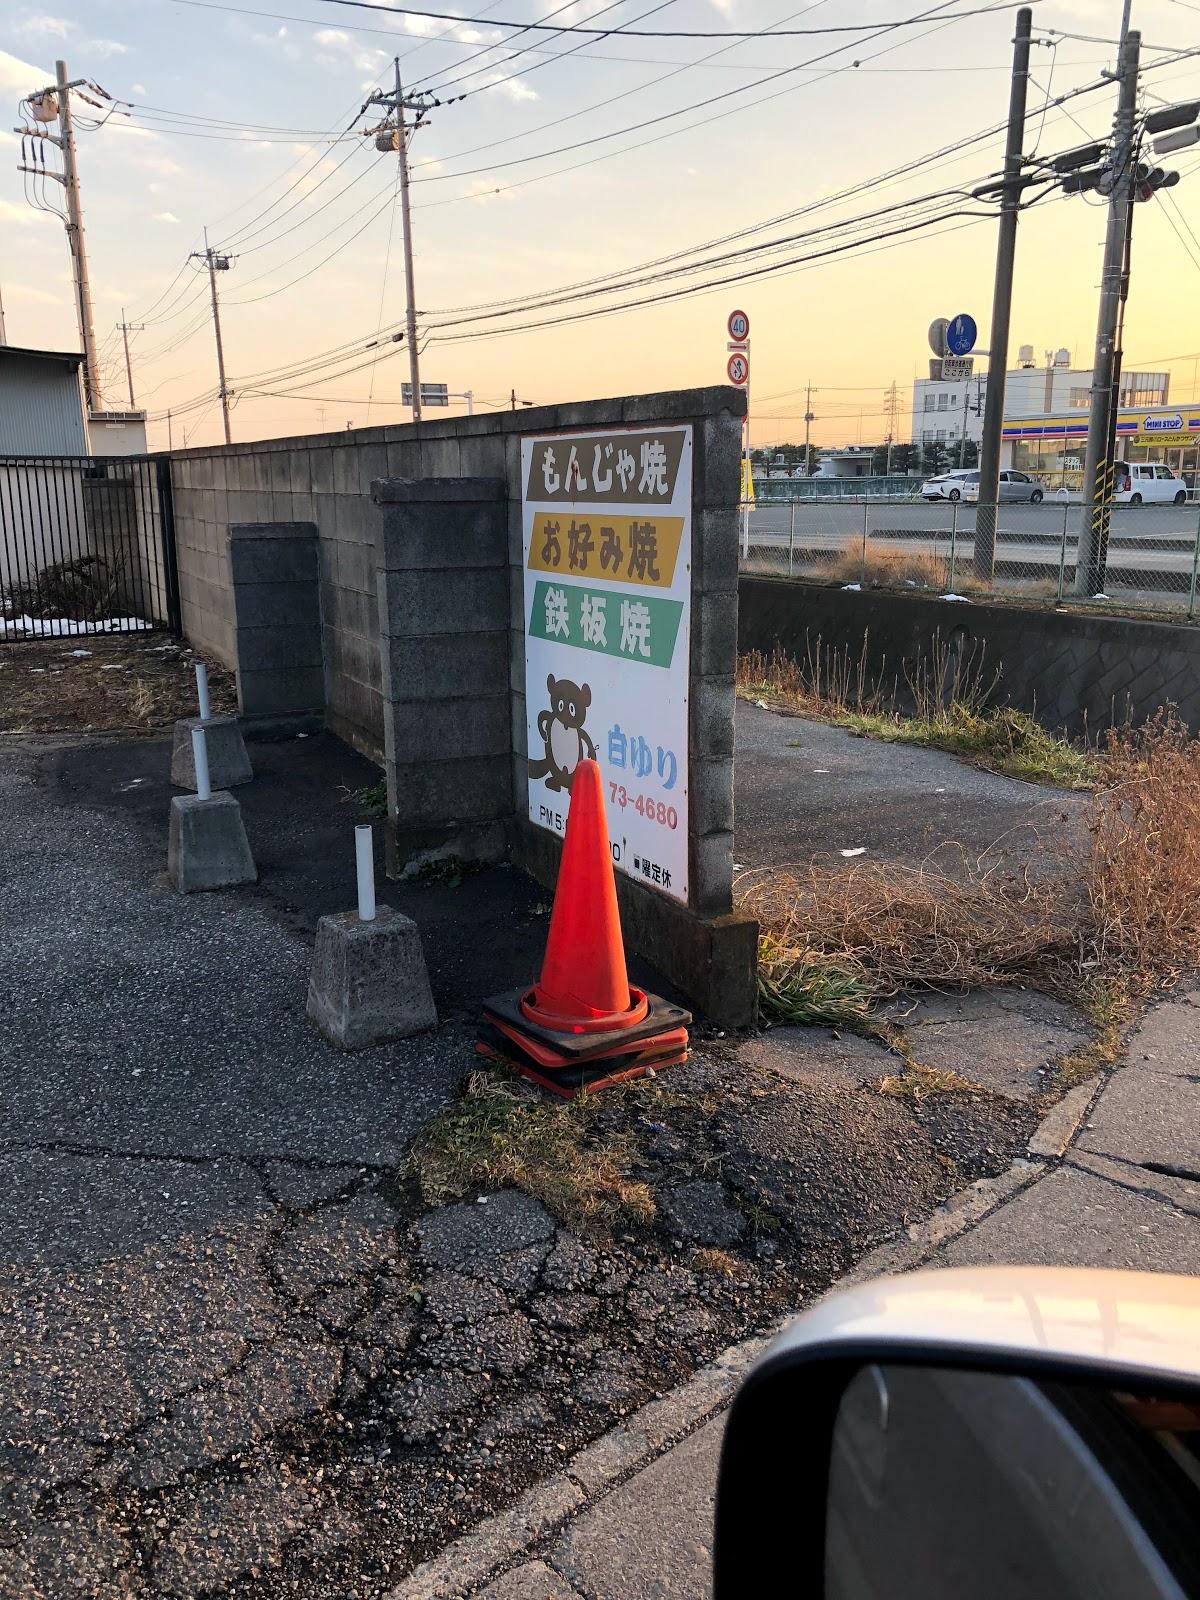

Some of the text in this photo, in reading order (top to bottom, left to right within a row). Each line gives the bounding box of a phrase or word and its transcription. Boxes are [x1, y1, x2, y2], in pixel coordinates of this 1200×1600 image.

[732, 319, 744, 333] 40
[944, 369, 970, 377] ここから
[1146, 419, 1180, 428] MINI STOP
[541, 440, 669, 495] もんじゃ焼
[541, 520, 661, 581] お好み焼
[544, 586, 651, 657] 鉄板焼
[607, 723, 678, 790] 白ゆり
[539, 805, 553, 826] PM
[555, 813, 568, 831] 5:
[609, 781, 678, 830] 73-4680
